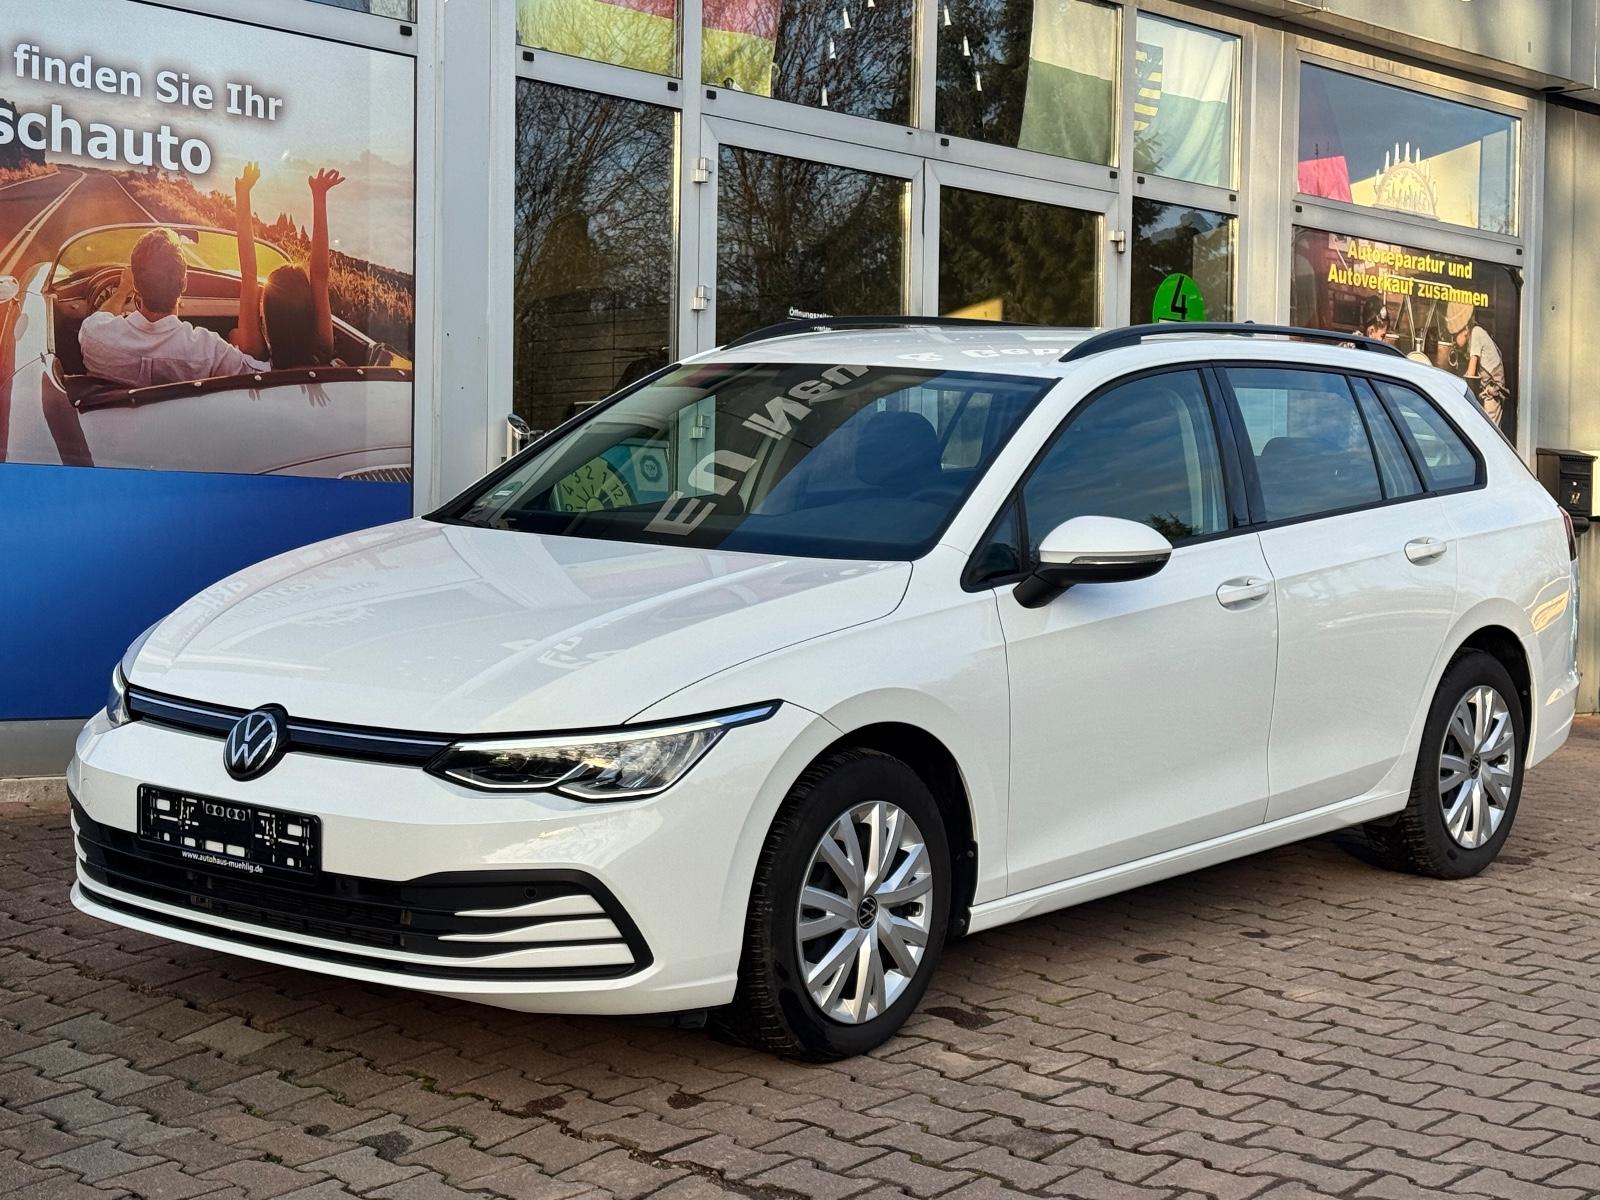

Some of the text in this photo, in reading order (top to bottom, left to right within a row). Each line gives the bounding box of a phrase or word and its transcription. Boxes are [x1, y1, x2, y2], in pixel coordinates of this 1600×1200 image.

[14, 43, 282, 121] finden Sie Ihr
[1347, 240, 1473, 280] Autoreparatur und
[1171, 275, 1188, 320] 4
[1327, 264, 1489, 308] Autoverkauf zusammen
[182, 850, 264, 873] www.autohaus-muehlig.de
